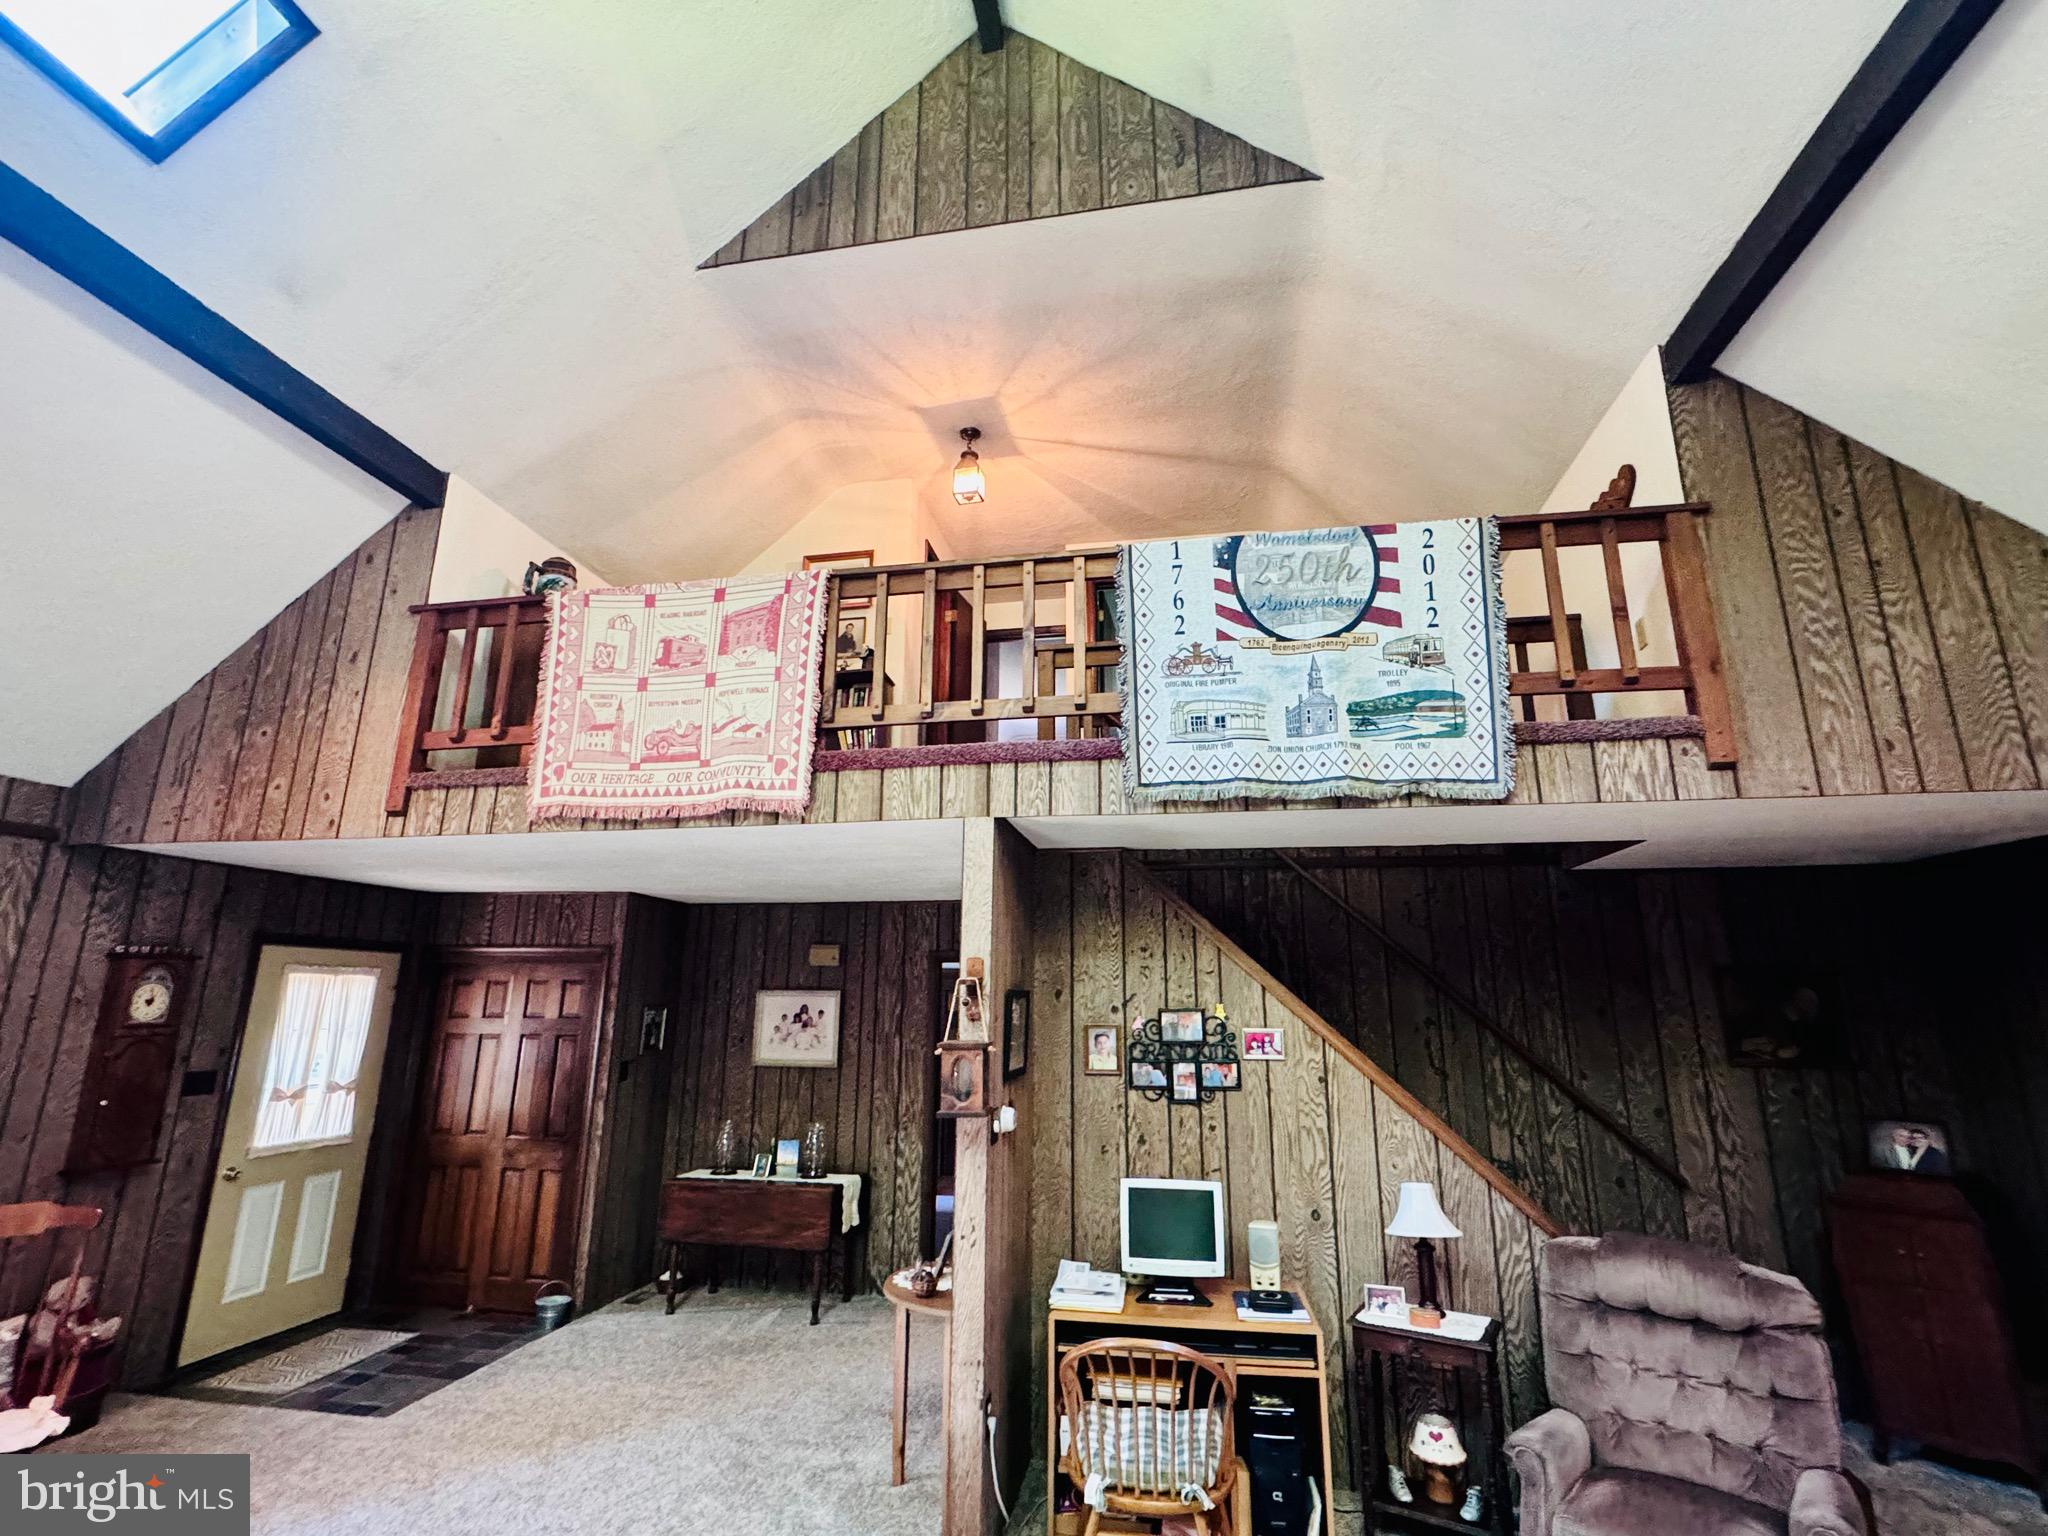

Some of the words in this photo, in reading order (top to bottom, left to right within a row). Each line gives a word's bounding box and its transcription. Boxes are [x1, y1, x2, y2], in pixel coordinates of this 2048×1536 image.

[1252, 545, 1363, 585] 250th
[1250, 593, 1366, 616] Anniversary
[1352, 636, 1370, 644] 2012
[1377, 669, 1408, 677] TROLLEY
[1164, 680, 1194, 688] ORIGINAL
[1195, 679, 1209, 687] FIRE
[1211, 677, 1237, 686] PUMPER
[1192, 744, 1219, 752] LIBRARY
[1284, 744, 1303, 752] UNION
[1305, 742, 1332, 752] CHURCH
[571, 772, 597, 784] OUR
[668, 771, 692, 784] OUR
